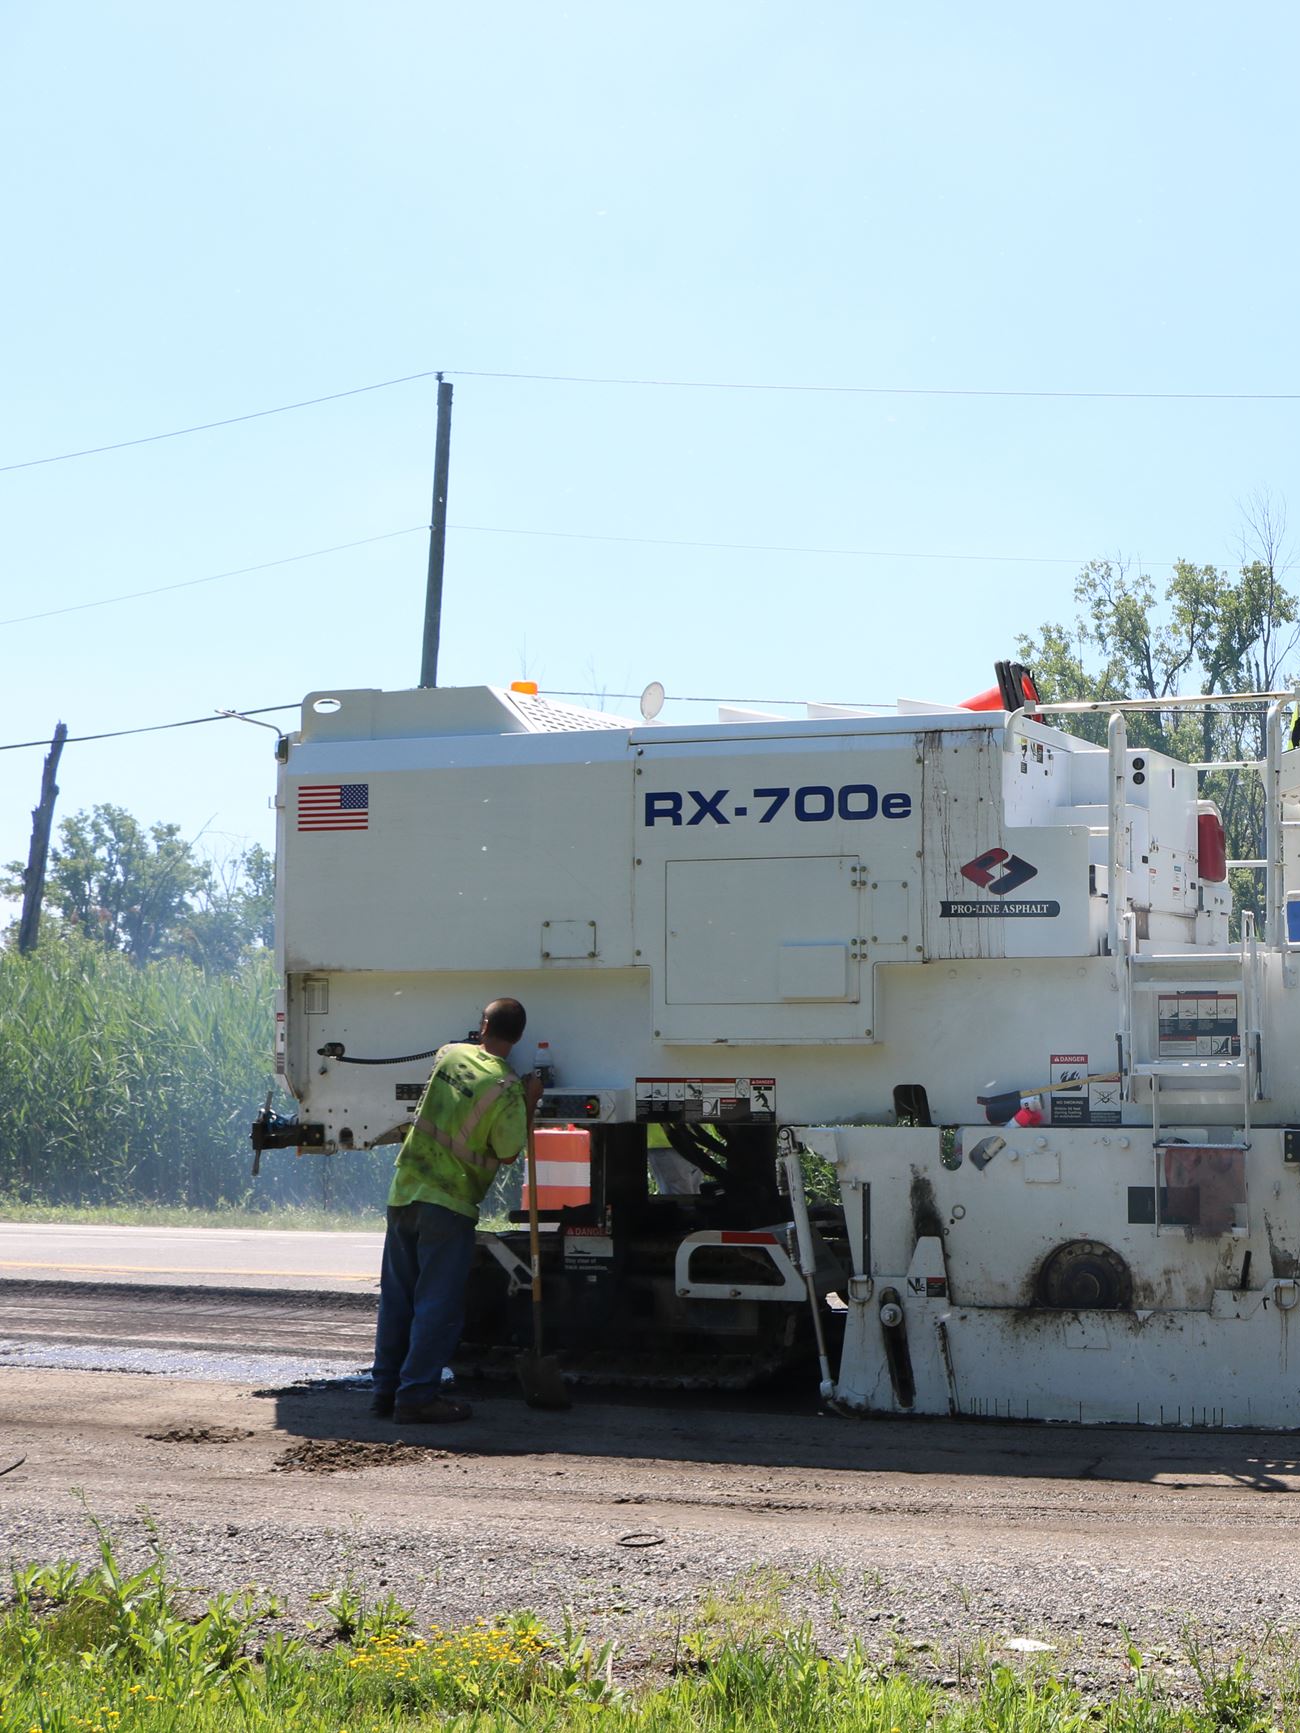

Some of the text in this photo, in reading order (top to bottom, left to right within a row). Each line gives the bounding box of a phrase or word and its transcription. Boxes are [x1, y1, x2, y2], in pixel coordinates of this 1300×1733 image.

[645, 784, 912, 827] RX-700e
[951, 904, 1049, 914] PRO-LINE ASPHALT
[575, 1227, 610, 1236] DANGE
